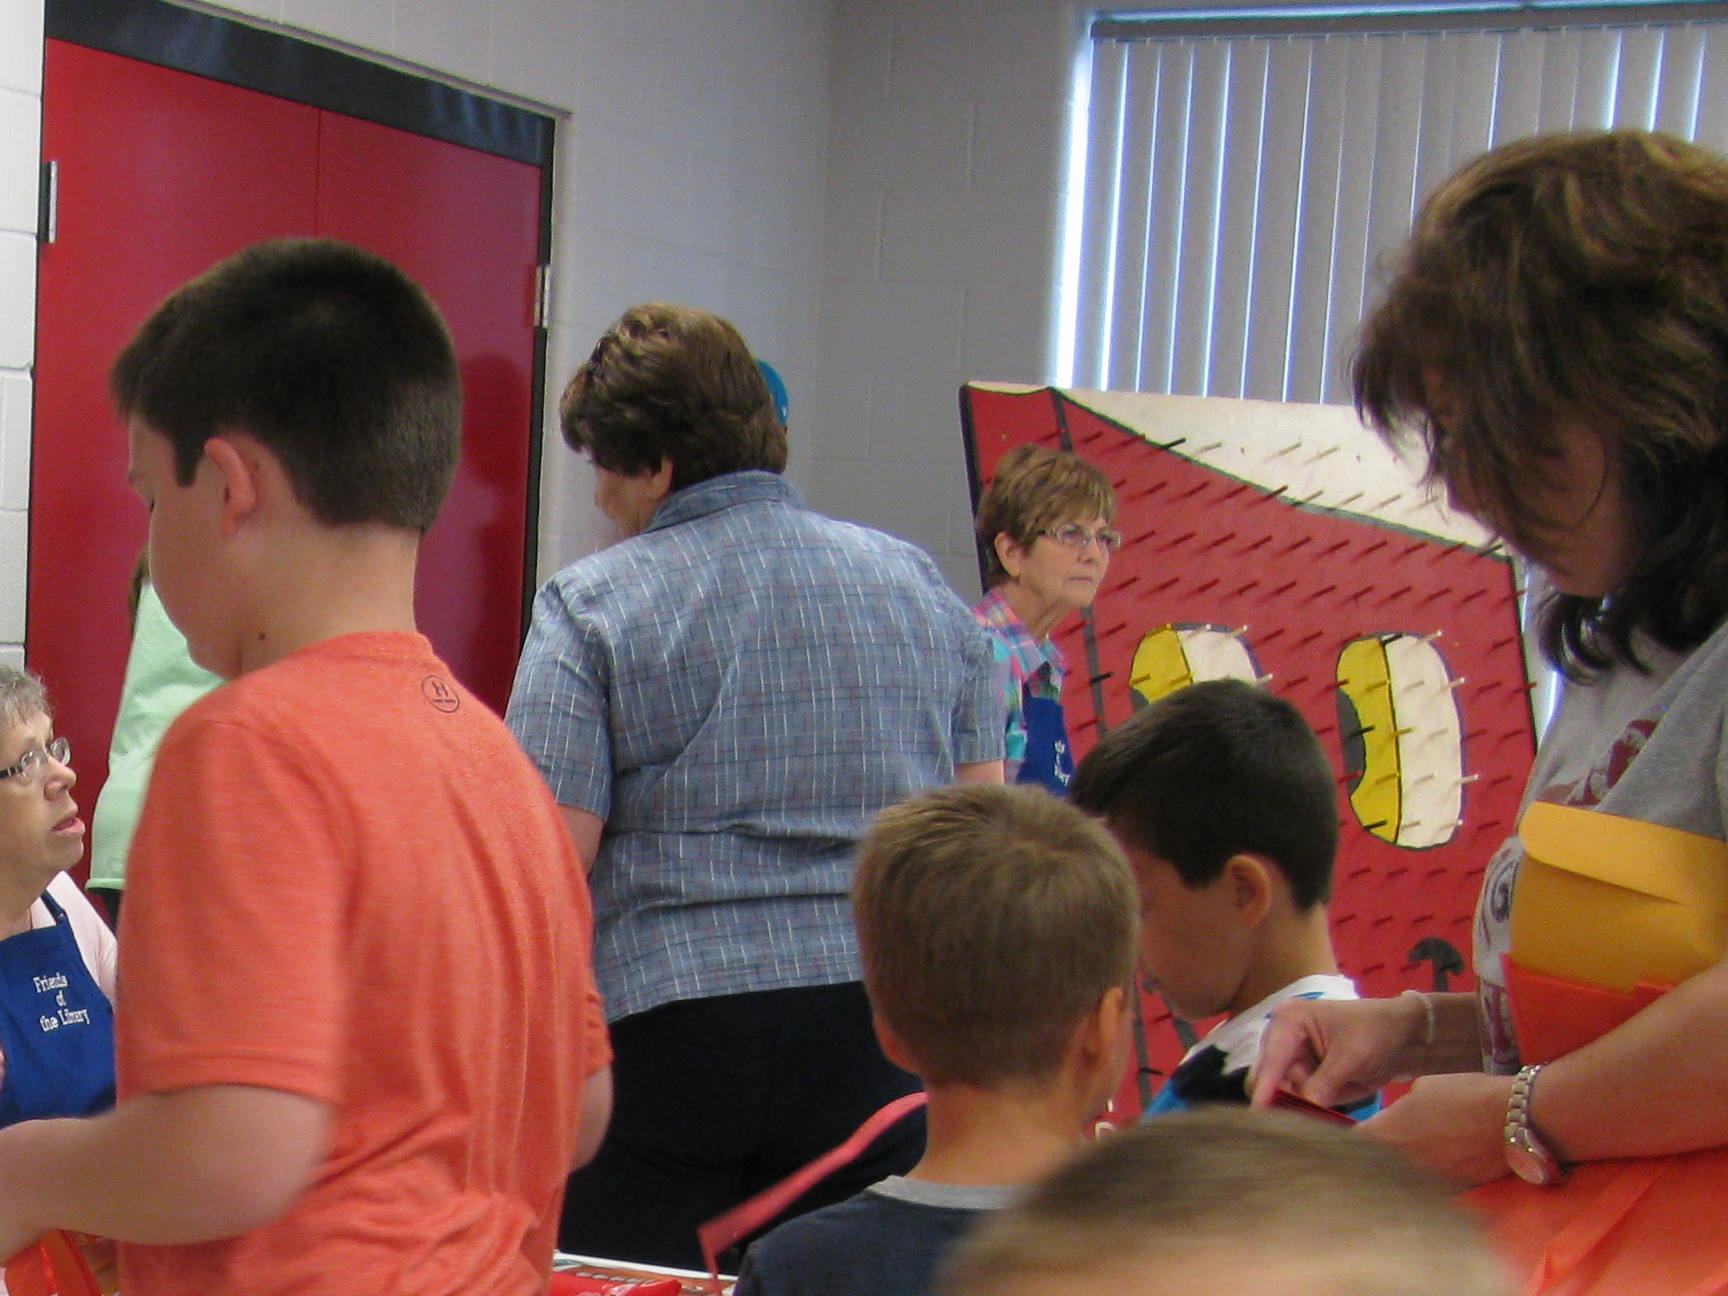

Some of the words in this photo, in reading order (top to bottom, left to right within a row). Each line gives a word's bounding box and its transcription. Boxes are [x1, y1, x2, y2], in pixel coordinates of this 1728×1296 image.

[32, 972, 68, 993] Friends
[39, 1014, 59, 1032] the
[57, 1008, 90, 1026] Library
